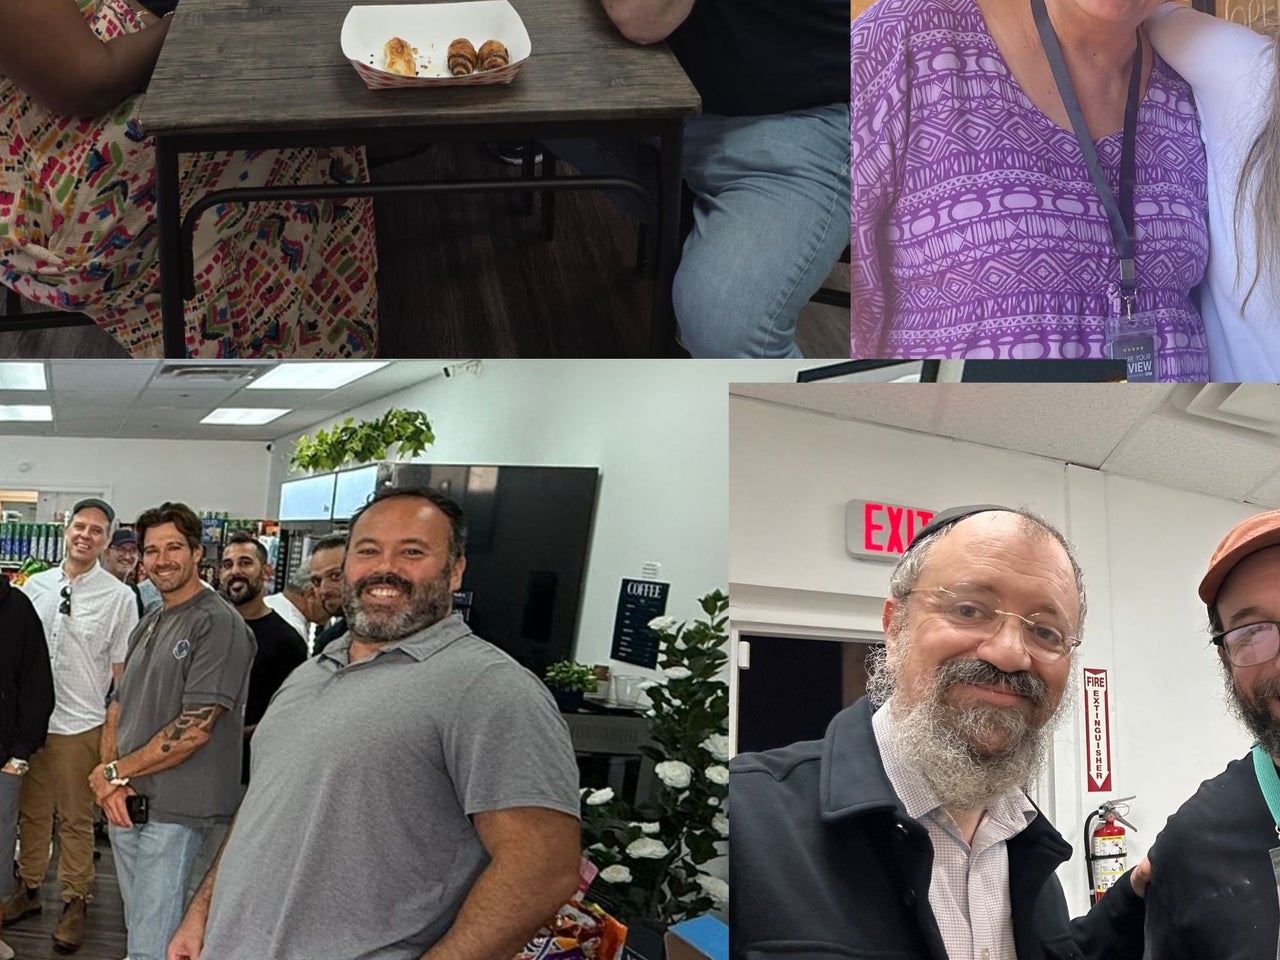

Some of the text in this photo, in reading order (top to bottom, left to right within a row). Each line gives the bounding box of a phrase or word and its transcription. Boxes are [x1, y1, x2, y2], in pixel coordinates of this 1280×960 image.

[864, 503, 934, 554] EXIT
[627, 581, 662, 599] COFFEE
[1087, 676, 1105, 688] FIRE
[1093, 690, 1103, 779] EXTINGUISHER
